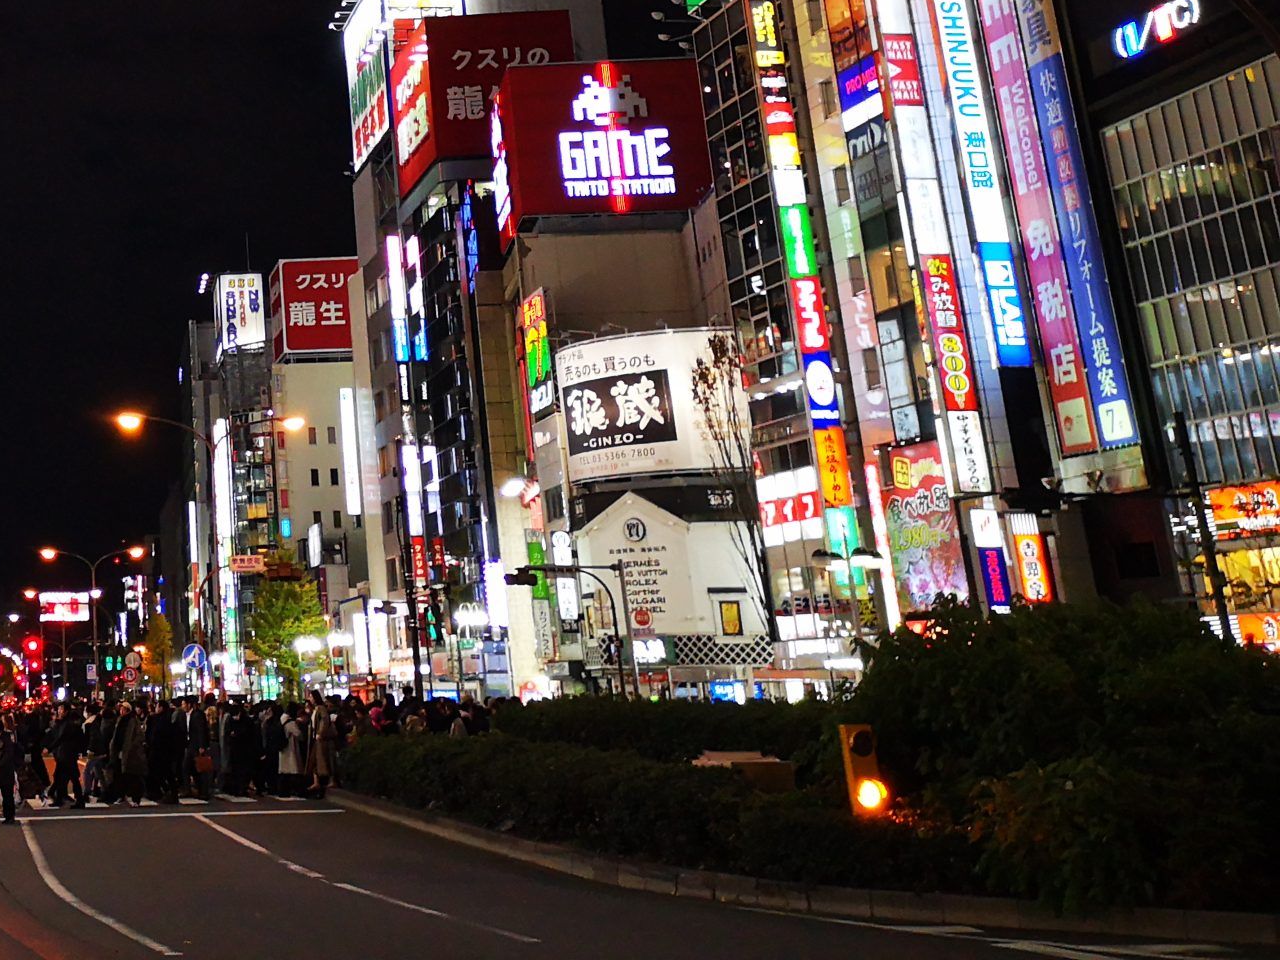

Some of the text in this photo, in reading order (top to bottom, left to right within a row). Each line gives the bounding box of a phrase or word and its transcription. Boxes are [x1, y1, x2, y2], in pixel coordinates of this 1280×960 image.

[452, 46, 550, 71] クスリの
[940, 1, 982, 118] SHINJUKU
[963, 131, 995, 190] 東口館
[558, 127, 674, 179] GAME
[1010, 78, 1042, 191] Welcome!
[564, 176, 677, 197] TAITO STATION
[288, 300, 346, 327] 龍生
[926, 257, 958, 328] 飲み放題
[1027, 218, 1078, 386] 免税店
[566, 374, 665, 436] 銀蔵
[637, 569, 668, 577] VUITTON
[984, 550, 1006, 603] PROMISE
[1021, 539, 1043, 600] 吉野家
